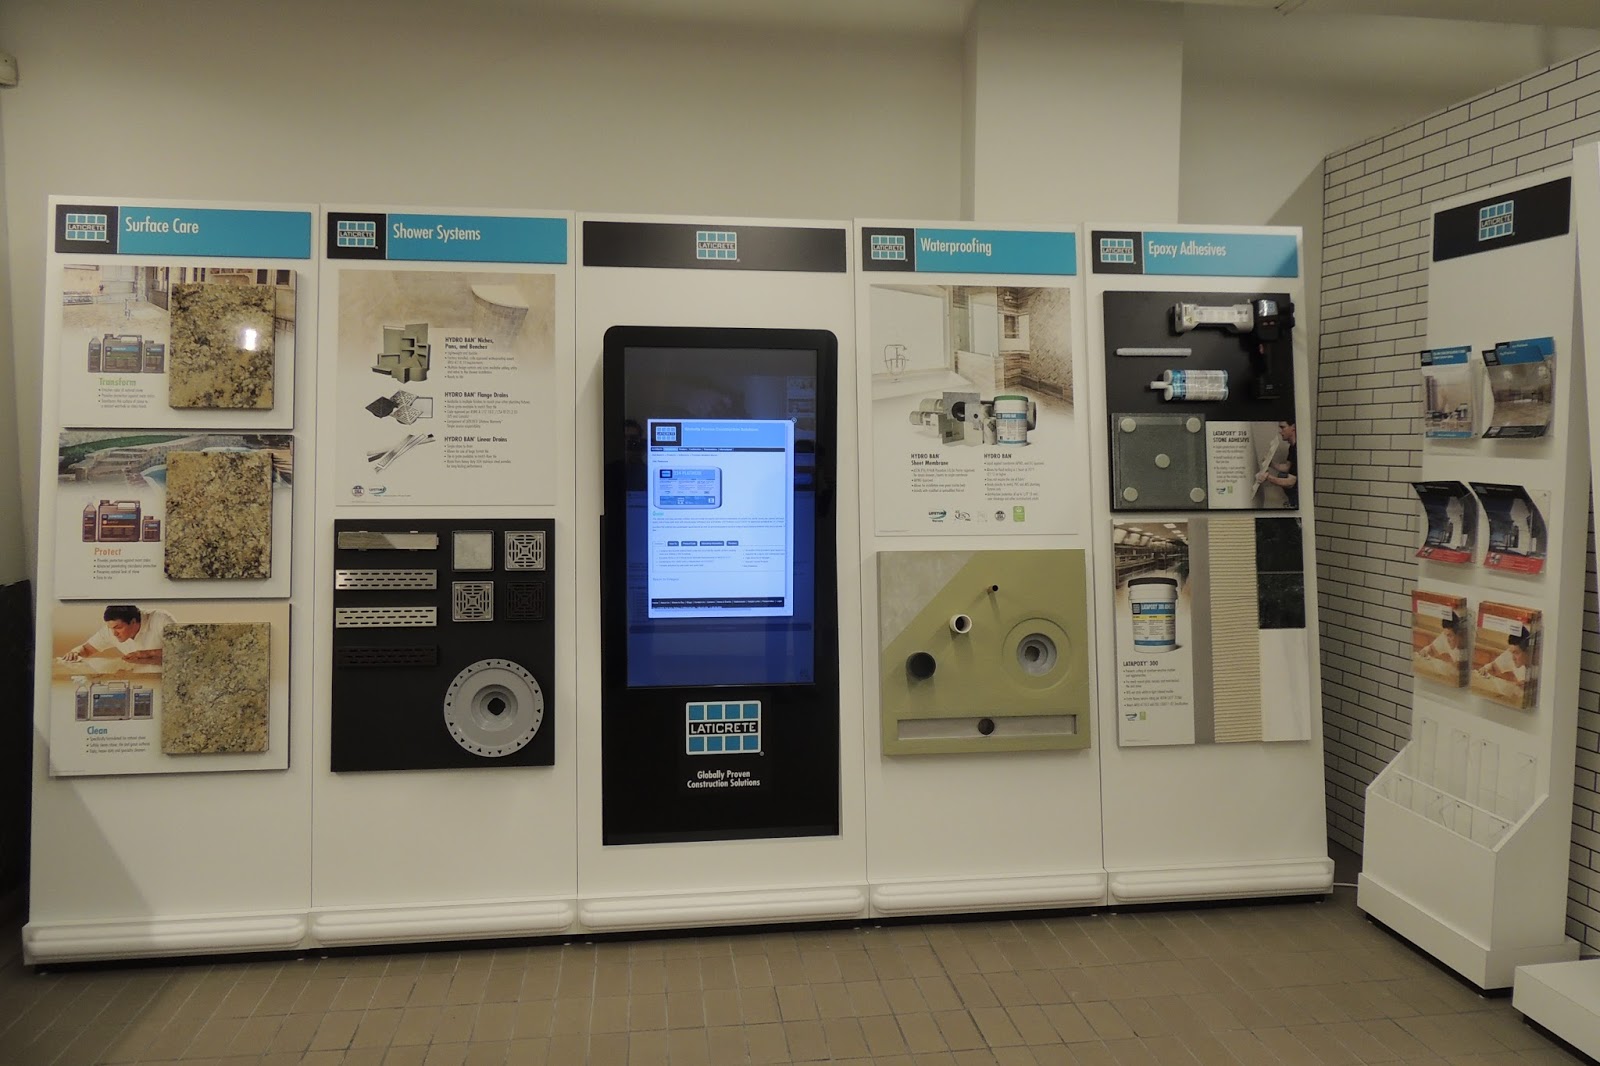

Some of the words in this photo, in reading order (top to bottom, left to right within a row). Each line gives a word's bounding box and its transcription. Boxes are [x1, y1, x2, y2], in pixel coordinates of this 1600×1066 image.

[125, 216, 169, 233] Surface
[172, 218, 199, 234] Care
[1481, 214, 1511, 228] LATICRETE
[67, 223, 105, 232] LATICRETE
[393, 224, 433, 239] Shower
[436, 225, 481, 243] Systems
[698, 242, 735, 250] LATICRETE
[920, 238, 992, 257] Waterproofing
[1148, 241, 1177, 258] Epoxy
[1179, 241, 1226, 256] Adhesives
[99, 377, 137, 387] Transform
[94, 547, 122, 556] Protect
[87, 726, 108, 735] Clean
[690, 722, 757, 734] LATICRETE
[697, 769, 725, 780] Globally
[726, 769, 751, 778] Proven
[687, 779, 729, 789] Construction
[730, 778, 761, 788] Solutions
